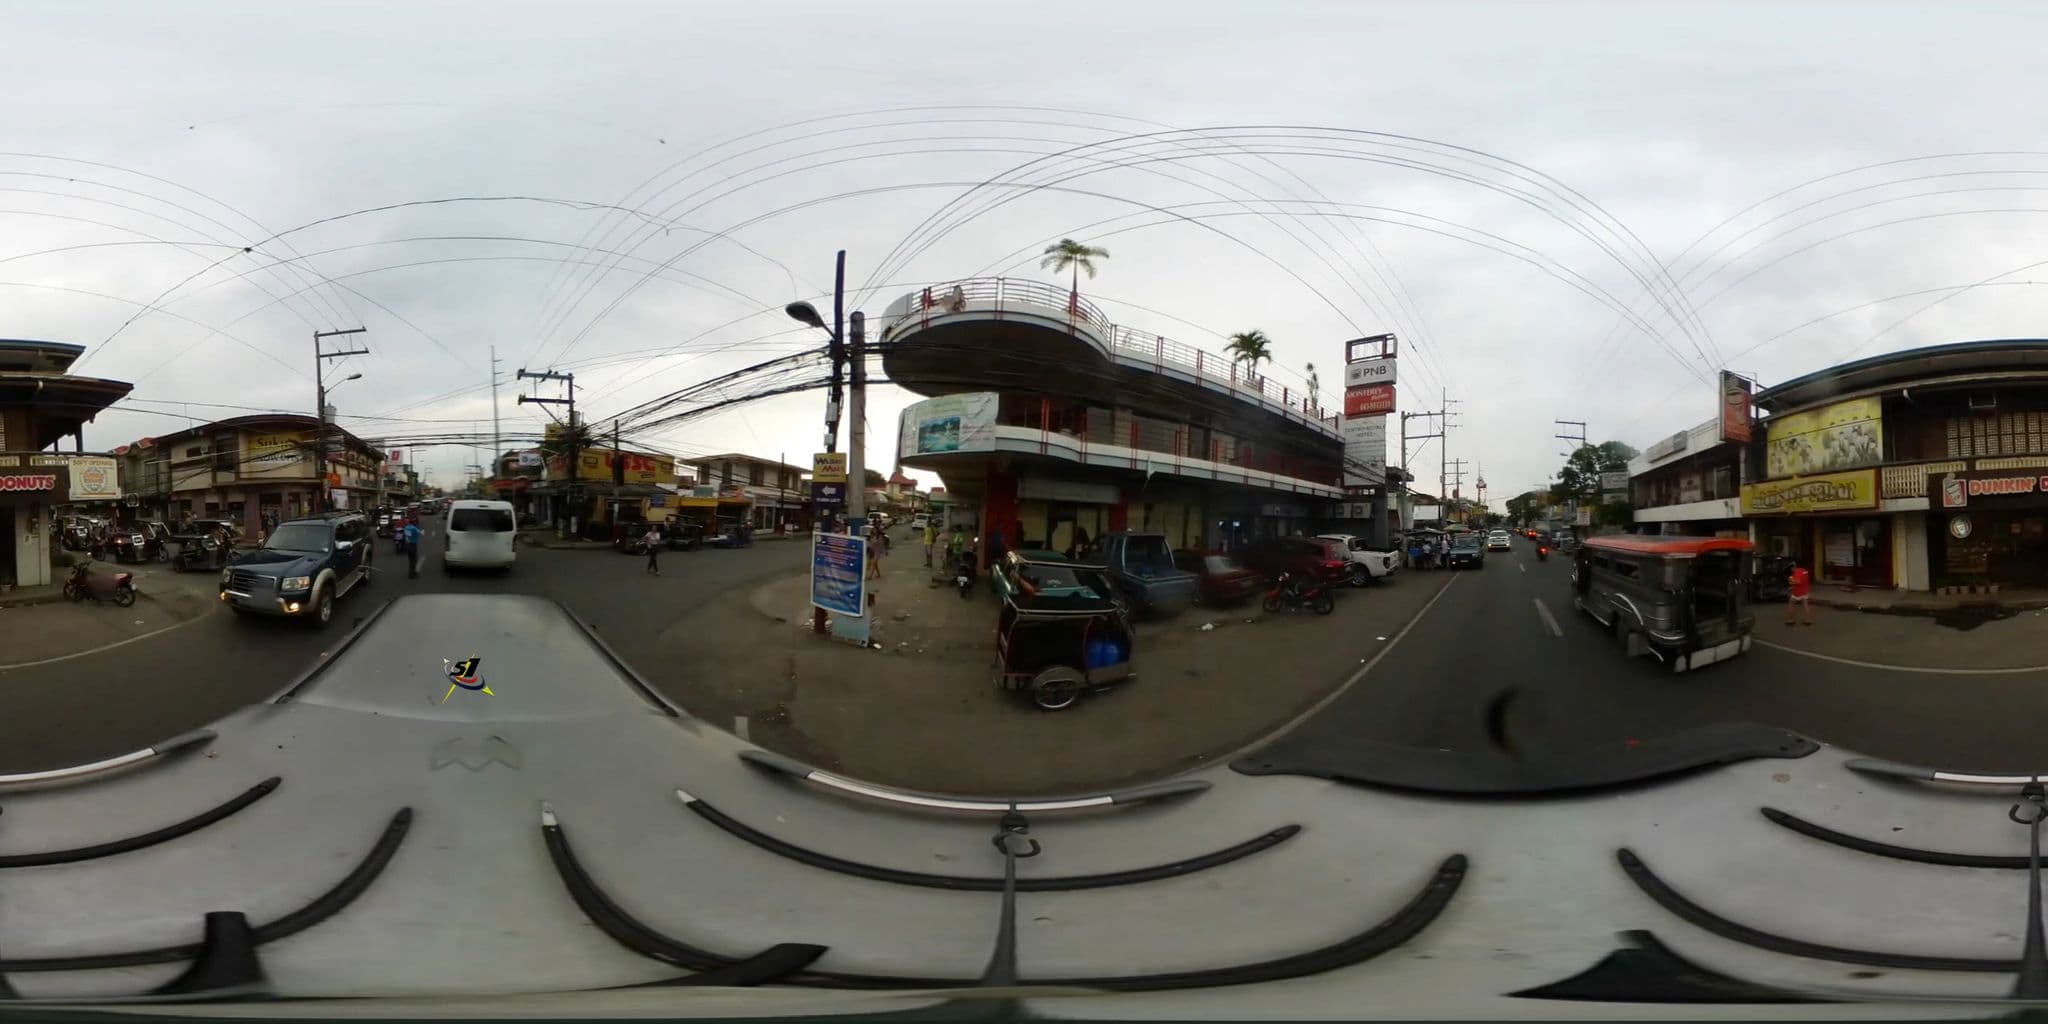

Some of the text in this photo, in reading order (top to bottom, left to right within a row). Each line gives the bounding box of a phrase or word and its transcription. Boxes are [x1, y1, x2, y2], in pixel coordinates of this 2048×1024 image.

[1363, 365, 1387, 377] PNB
[1346, 388, 1382, 399] MONTEREY
[1969, 477, 2036, 495] DUNKIN'
